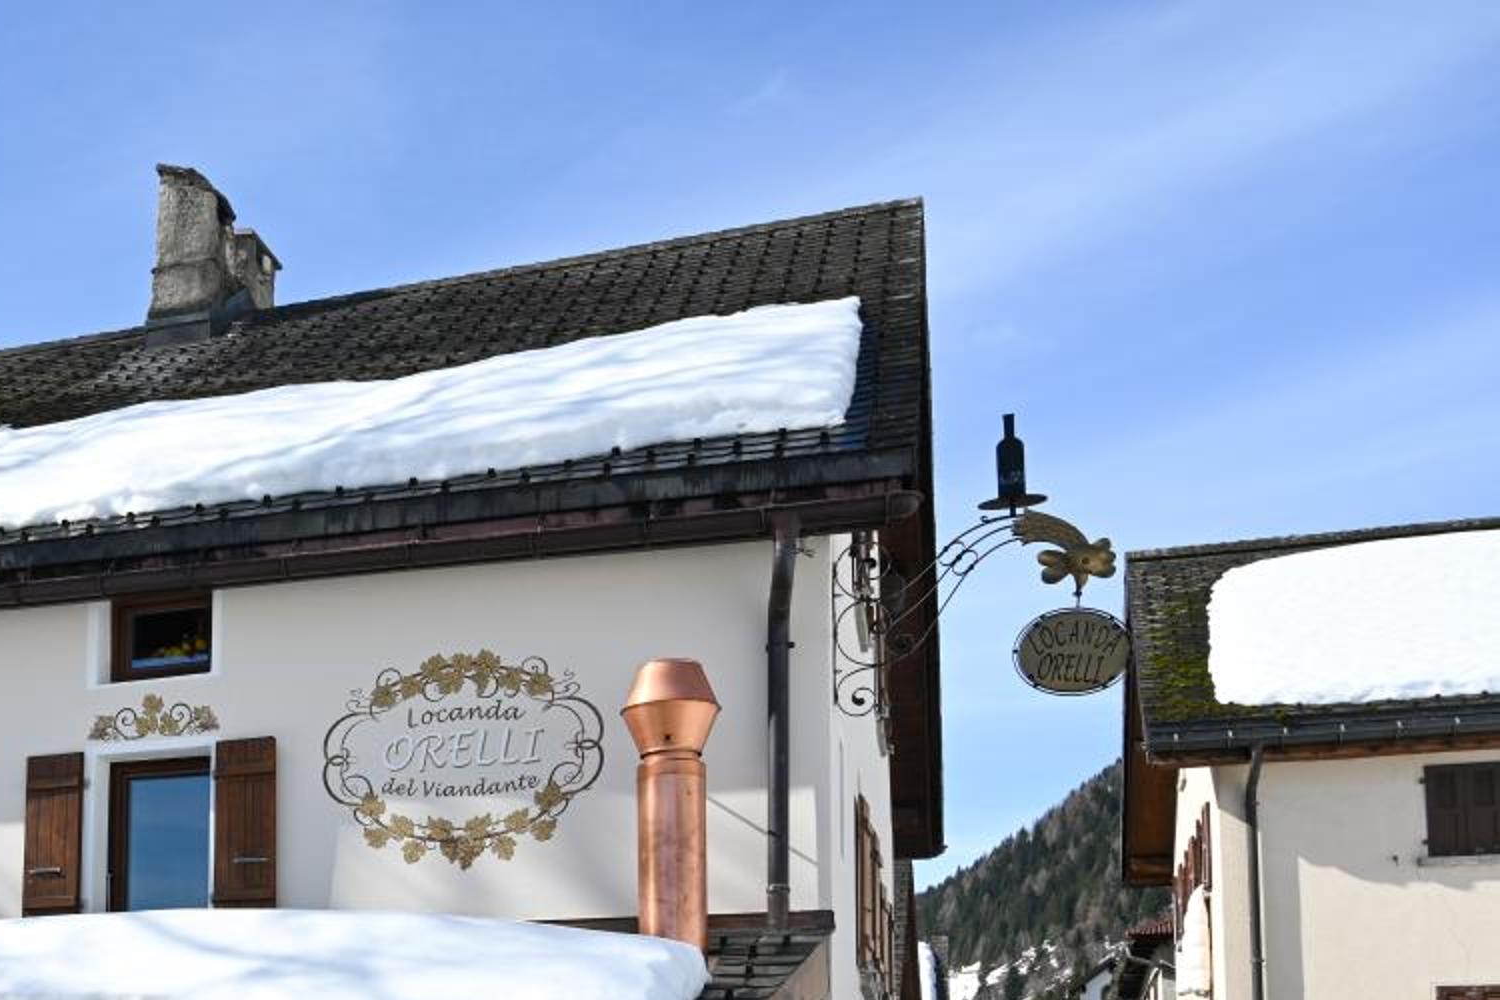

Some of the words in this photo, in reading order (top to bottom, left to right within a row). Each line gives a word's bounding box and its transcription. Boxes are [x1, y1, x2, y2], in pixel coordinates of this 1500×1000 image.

[1027, 620, 1121, 657] LOCANDA
[1037, 652, 1105, 684] ORELLI
[407, 700, 525, 728] Locanda
[385, 726, 545, 773] ORELLI
[381, 777, 418, 797] del
[422, 774, 541, 798] Viandante
